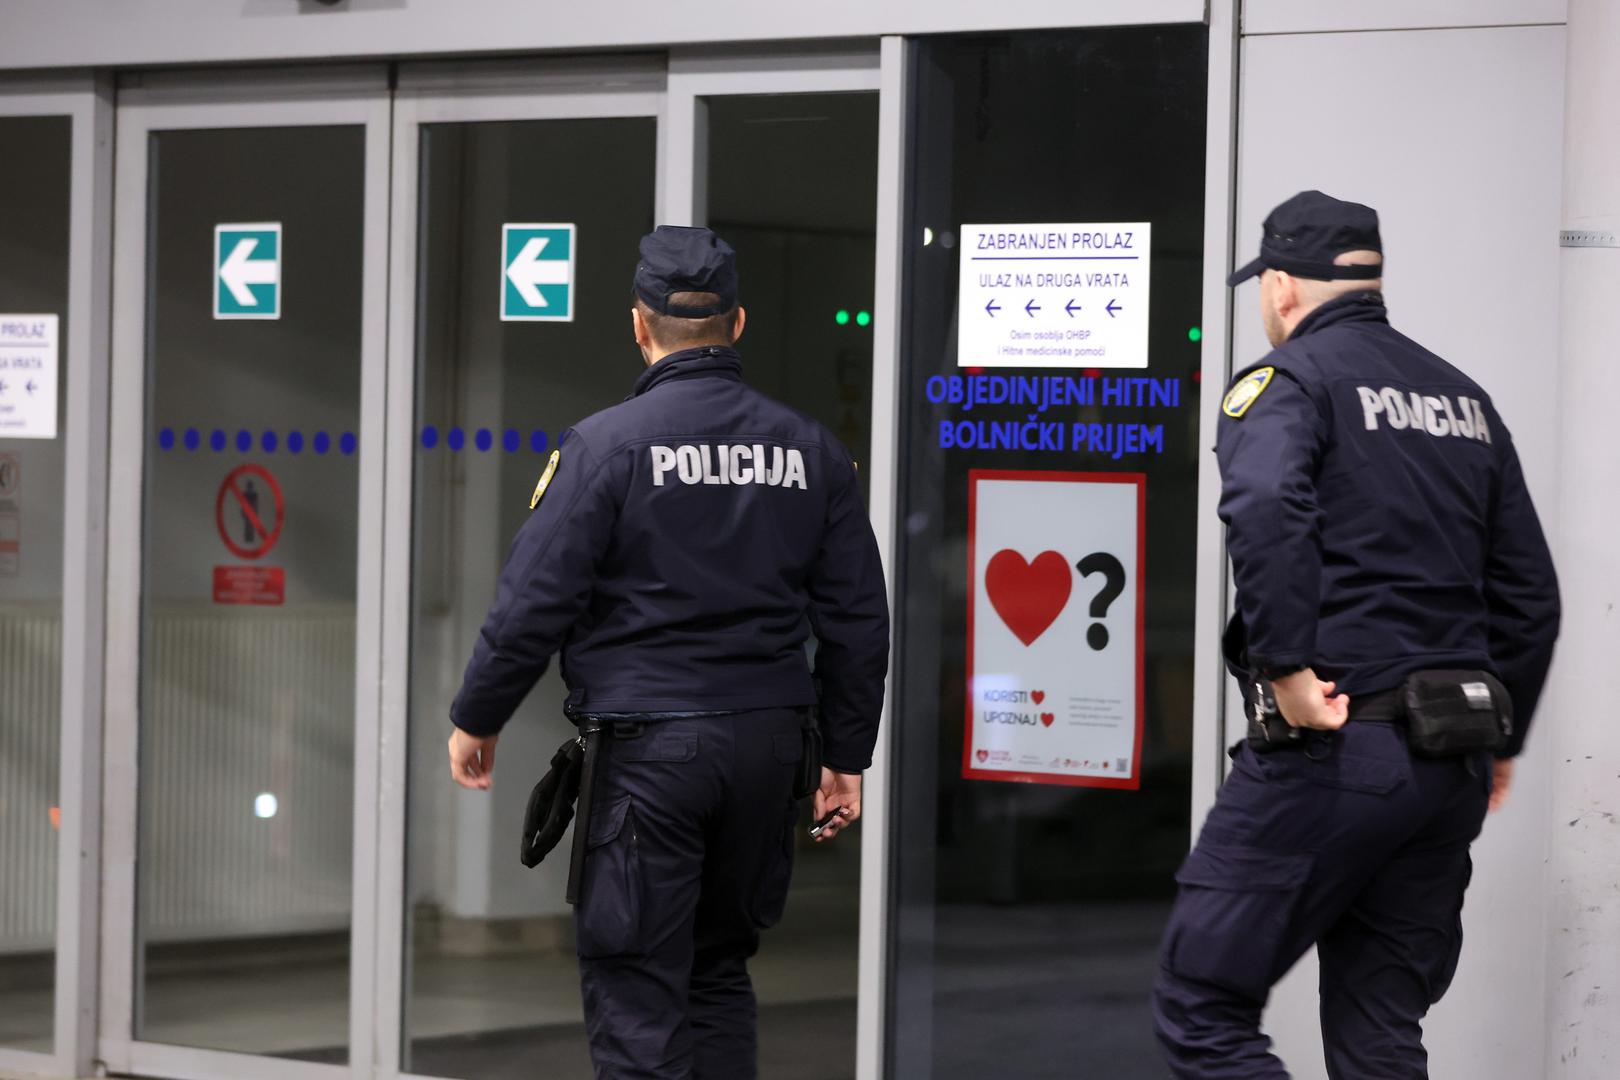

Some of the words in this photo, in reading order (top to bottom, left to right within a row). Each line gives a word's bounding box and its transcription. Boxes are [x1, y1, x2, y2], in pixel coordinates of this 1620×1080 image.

[977, 233, 1067, 250] ZABRANJEN
[1072, 232, 1133, 249] PROLAZ
[979, 273, 1012, 288] ULAZ
[1015, 273, 1033, 288] NA
[1036, 273, 1082, 288] DRUGA
[1086, 273, 1129, 288] VRATA
[1010, 329, 1032, 340] Osim
[1066, 329, 1091, 340] OHBP
[925, 375, 1094, 412] OBJEDINJENI
[1101, 377, 1179, 407] HITNI
[938, 414, 1064, 450] BOLNIČKI
[1072, 423, 1163, 459] PRIJEM
[650, 444, 807, 490] POLICIJA
[983, 689, 1028, 704] KORISTI
[983, 711, 1037, 726] UPOZNAJ
